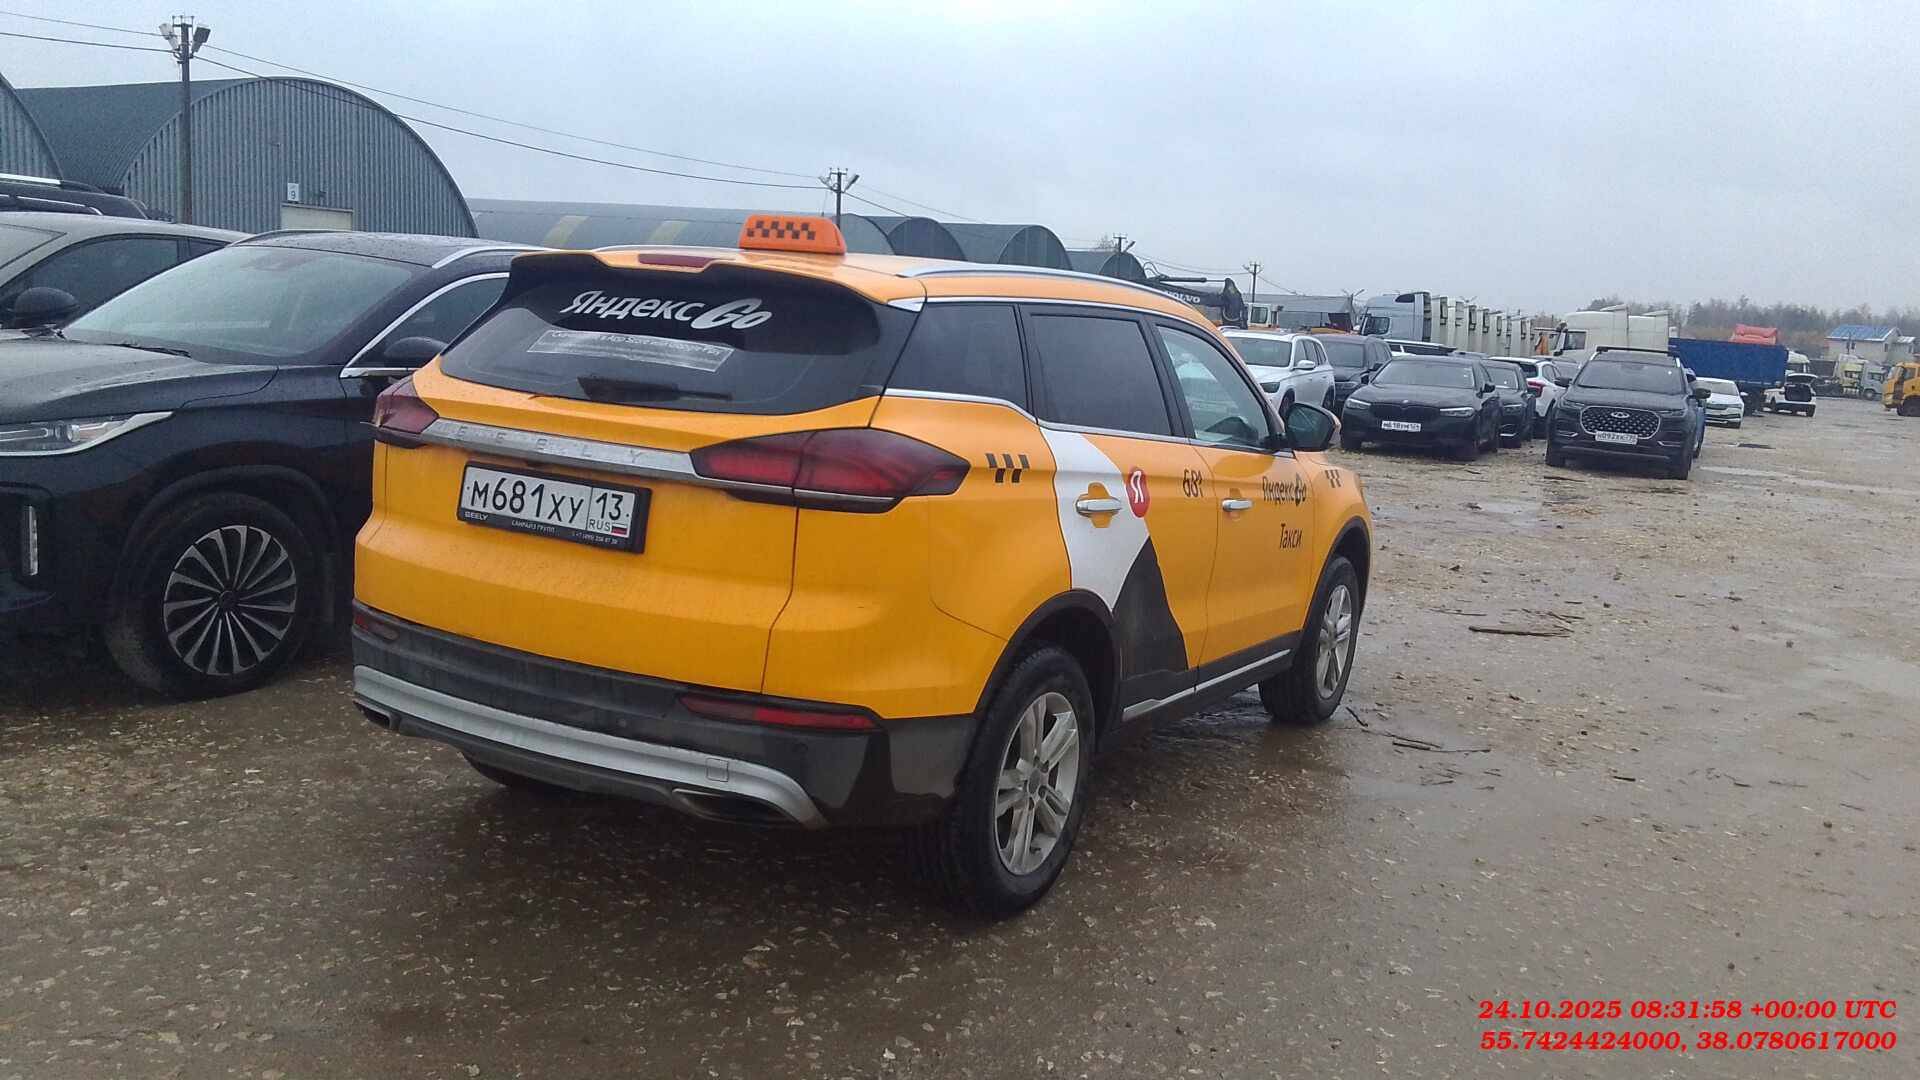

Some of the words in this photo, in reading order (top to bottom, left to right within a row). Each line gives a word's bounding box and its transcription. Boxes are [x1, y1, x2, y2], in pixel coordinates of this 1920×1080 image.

[559, 290, 706, 322] Яндекс
[690, 298, 773, 329] Go
[1182, 468, 1204, 498] 681
[1279, 523, 1303, 549] Такси
